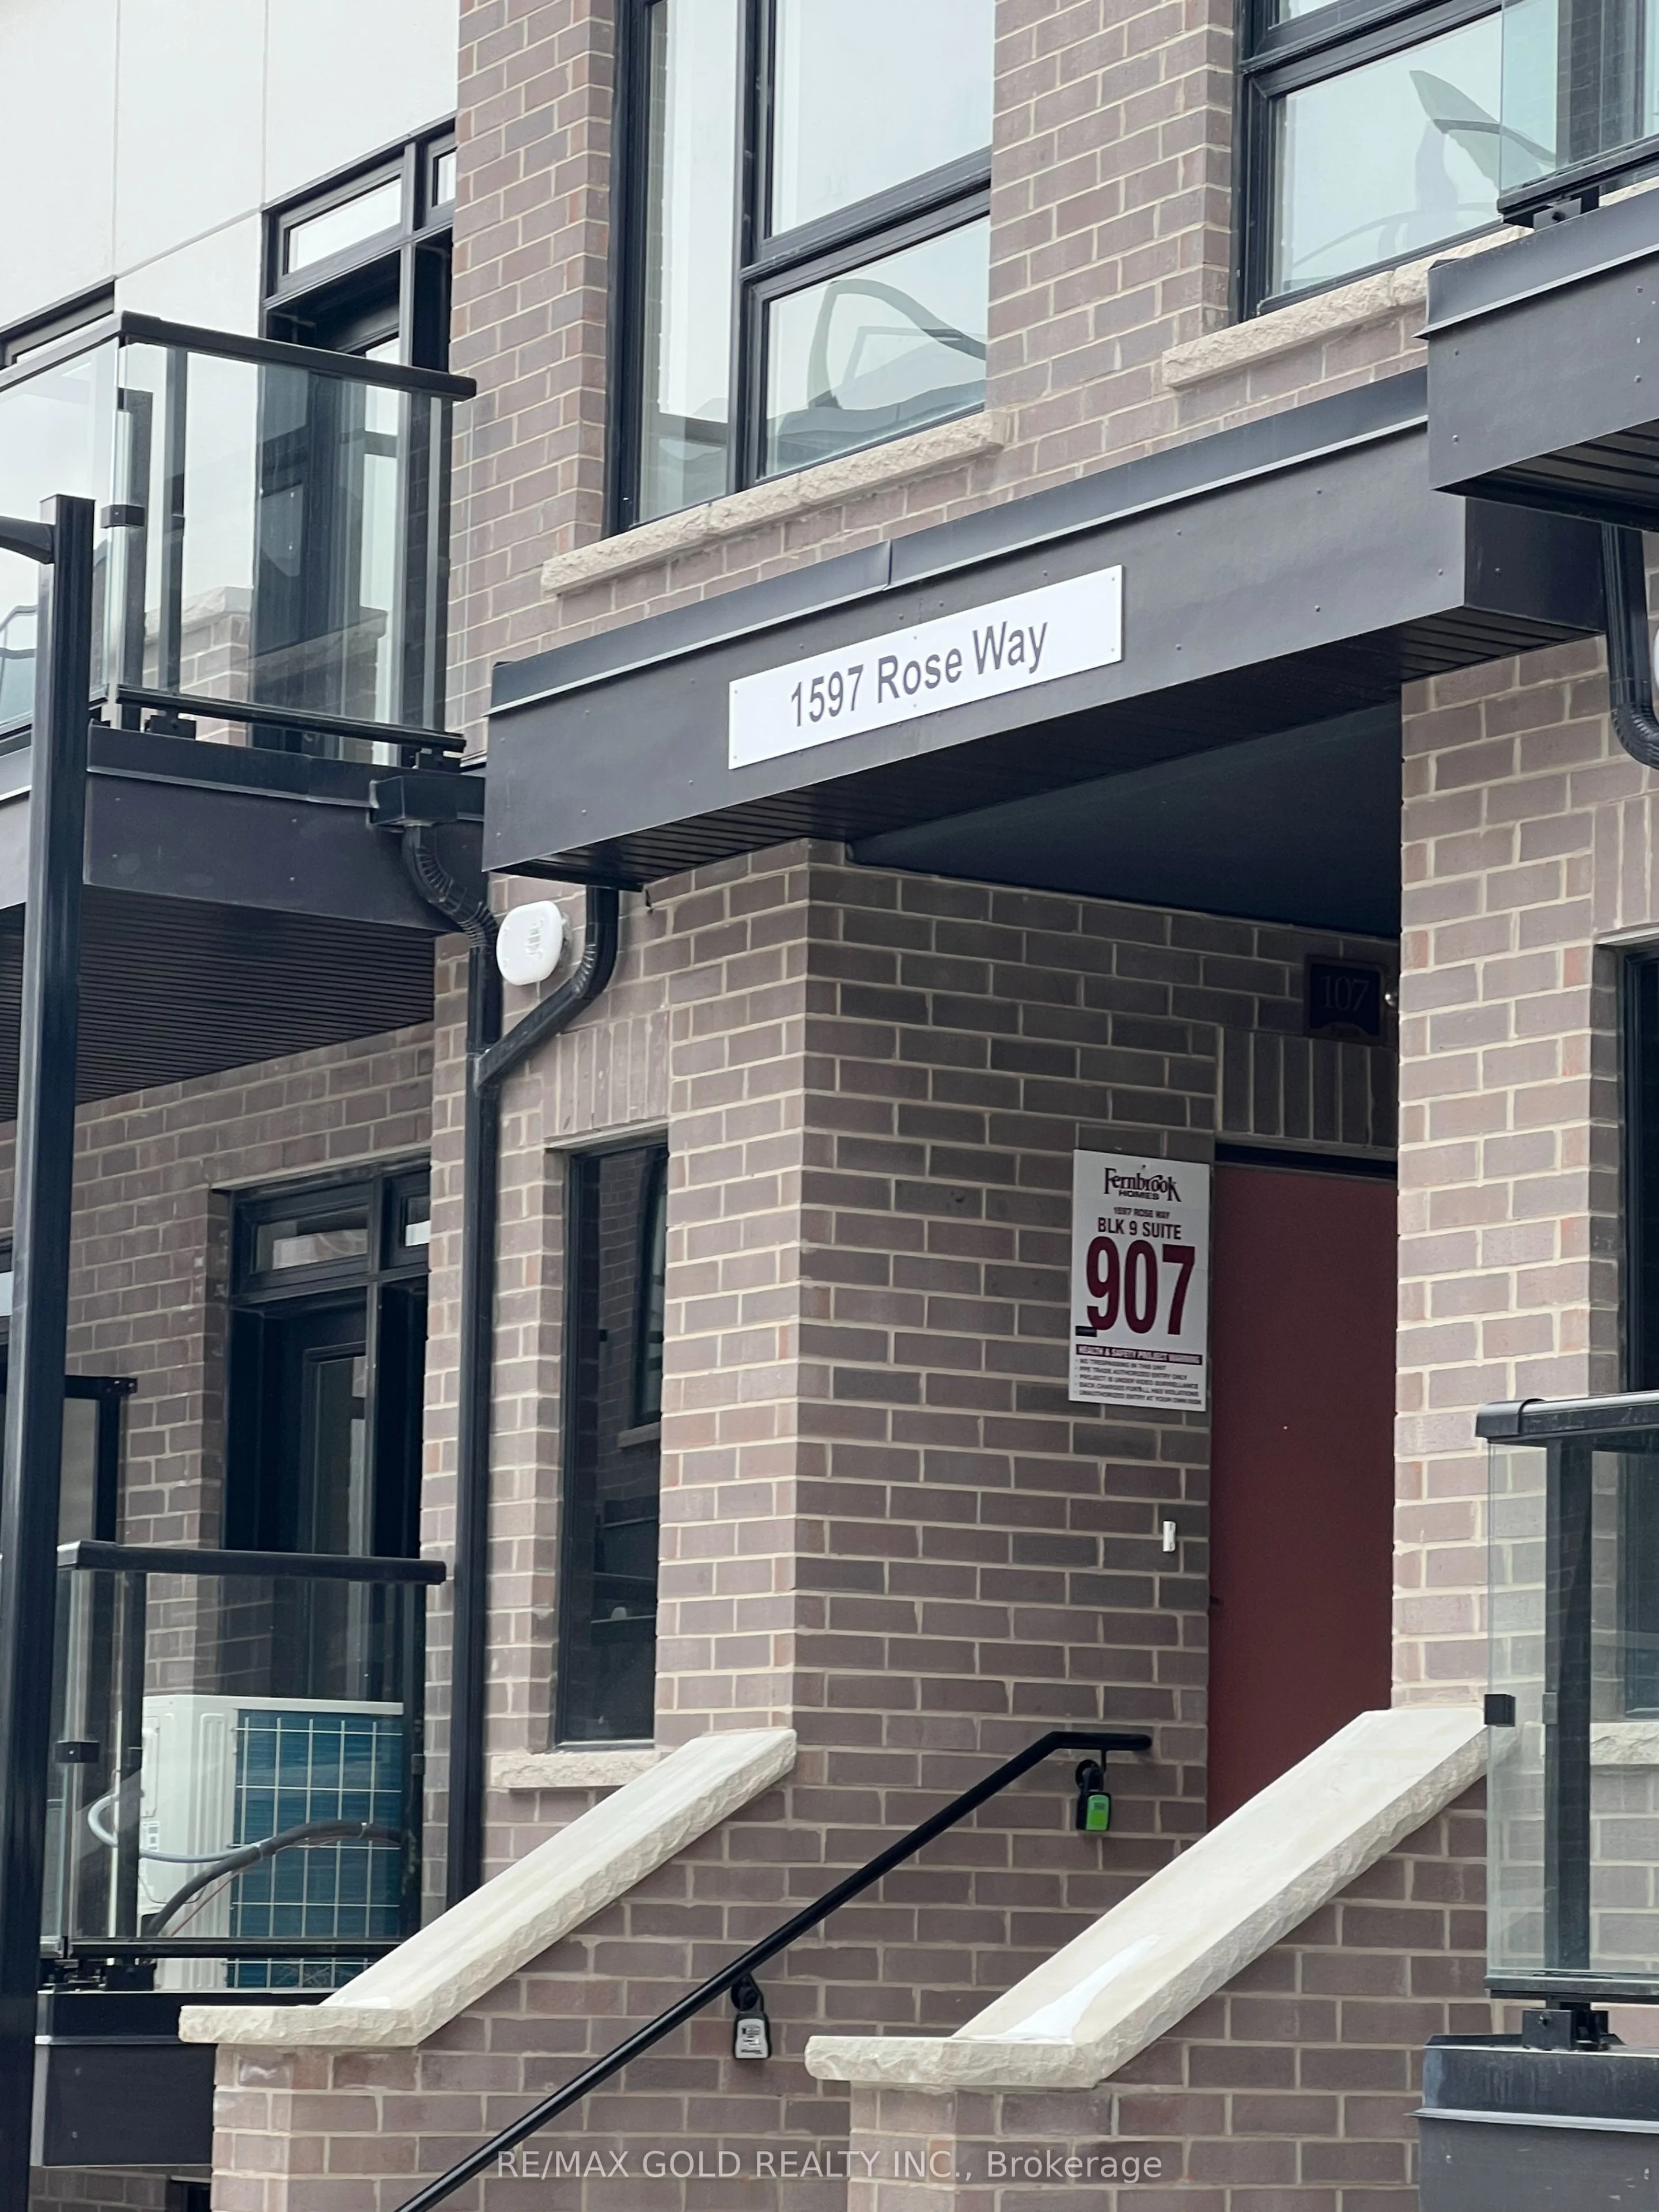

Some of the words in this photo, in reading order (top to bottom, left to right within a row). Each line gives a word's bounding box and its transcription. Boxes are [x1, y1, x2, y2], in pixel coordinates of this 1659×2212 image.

[791, 664, 863, 726] 1597
[877, 648, 963, 704] Rose
[972, 621, 1048, 674] Way
[1320, 975, 1370, 1012] 107
[1103, 1168, 1181, 1202] Fernbrook
[1119, 1190, 1159, 1200] HOMES
[1098, 1217, 1124, 1234] BLK
[1129, 1221, 1137, 1236] 9
[1142, 1222, 1181, 1240] SUITE
[1086, 1236, 1195, 1335] 907
